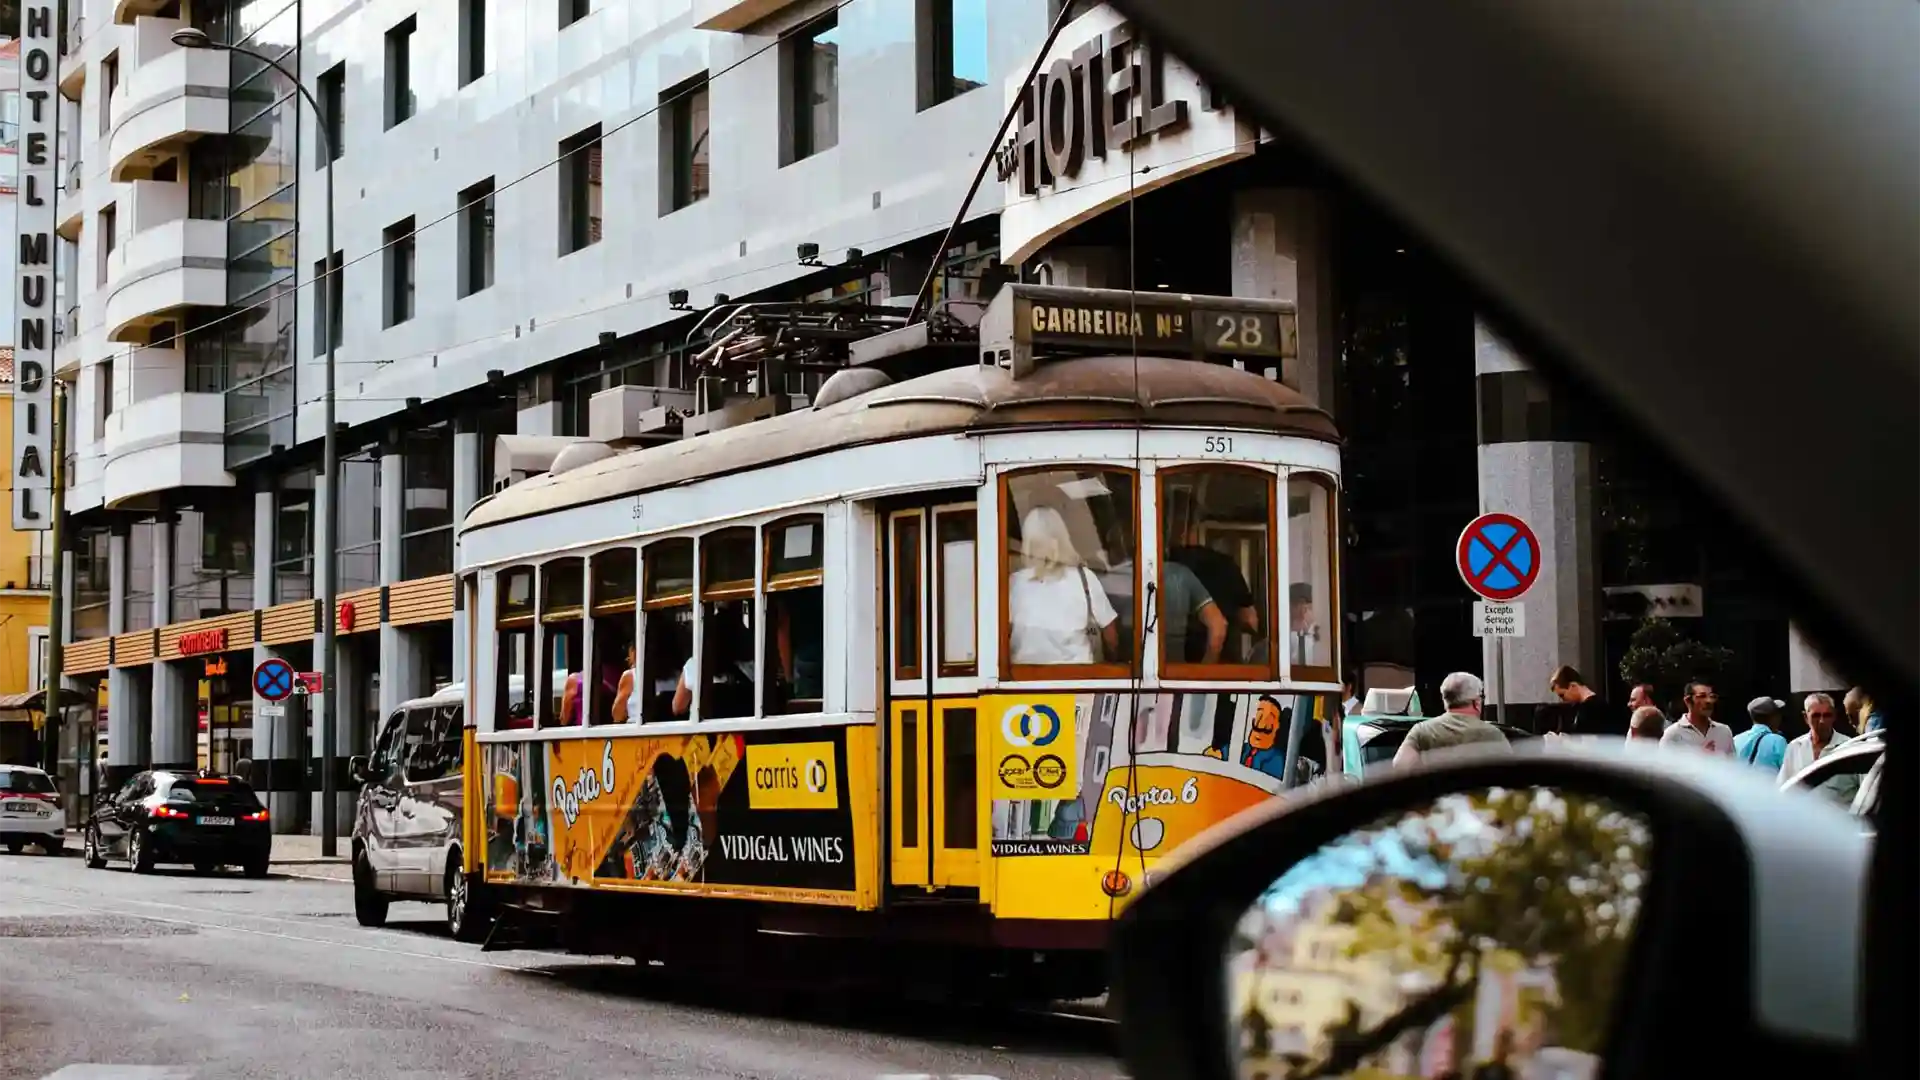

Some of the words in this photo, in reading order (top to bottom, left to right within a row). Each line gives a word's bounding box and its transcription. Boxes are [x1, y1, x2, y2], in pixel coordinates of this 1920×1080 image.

[26, 6, 50, 207] HOTEL
[1016, 20, 1188, 198] HOTEL
[1031, 304, 1144, 337] CARREIRA
[1216, 314, 1263, 349] 28
[19, 233, 48, 520] MUNDIAL
[1204, 436, 1234, 454] 551
[552, 766, 600, 830] Porta
[602, 739, 616, 794] 6
[756, 757, 798, 790] carris
[1107, 785, 1177, 816] Porta
[1182, 776, 1198, 804] 6
[720, 834, 789, 861] VIDIGAL
[791, 835, 844, 864] WINES
[992, 843, 1044, 854] VIDIGAL
[1047, 843, 1086, 854] WINES
